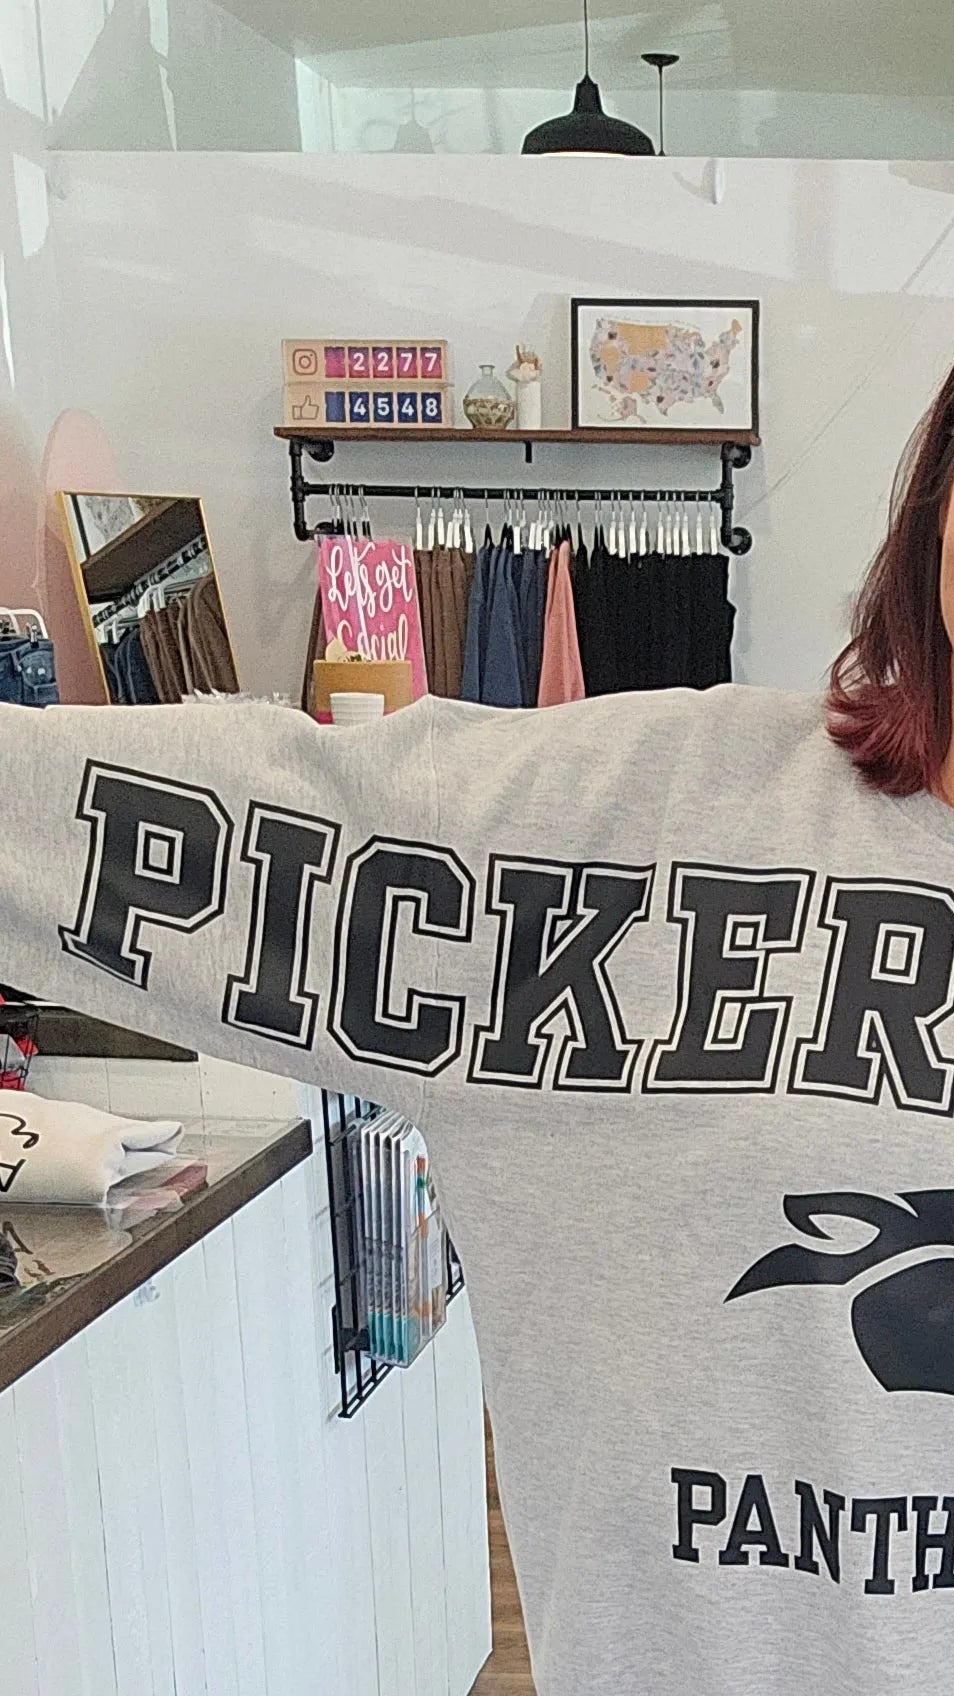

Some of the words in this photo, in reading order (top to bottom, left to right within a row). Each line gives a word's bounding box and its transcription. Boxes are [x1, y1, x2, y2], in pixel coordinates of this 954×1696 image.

[353, 352, 438, 372] 2277
[353, 397, 438, 417] 4548
[375, 545, 412, 612] get
